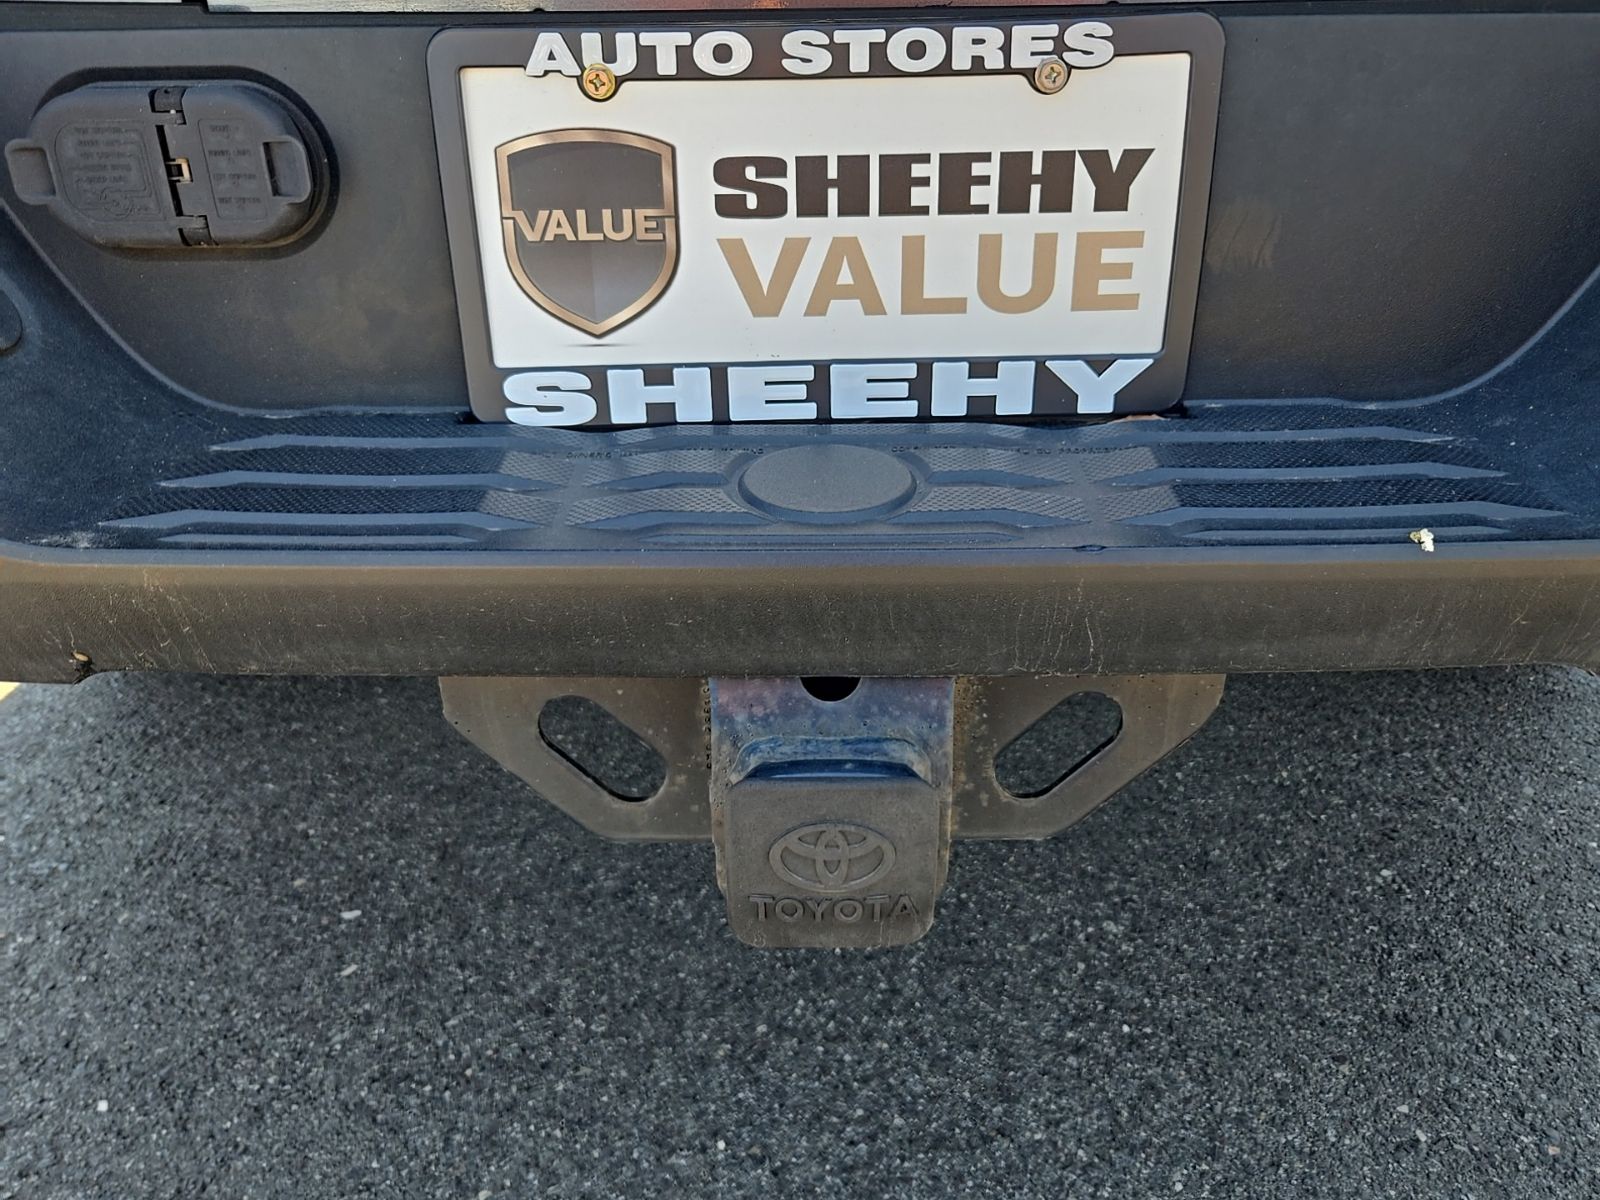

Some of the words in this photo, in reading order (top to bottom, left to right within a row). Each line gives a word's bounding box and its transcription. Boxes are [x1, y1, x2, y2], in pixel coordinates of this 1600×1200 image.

[525, 30, 753, 77] AUTO
[781, 21, 1115, 75] STORES
[712, 148, 1155, 219] SHEEHY
[511, 208, 665, 242] VALUE
[716, 230, 1145, 319] VALUE
[502, 358, 1154, 427] SHEEHY
[748, 893, 920, 923] TOYOTA
